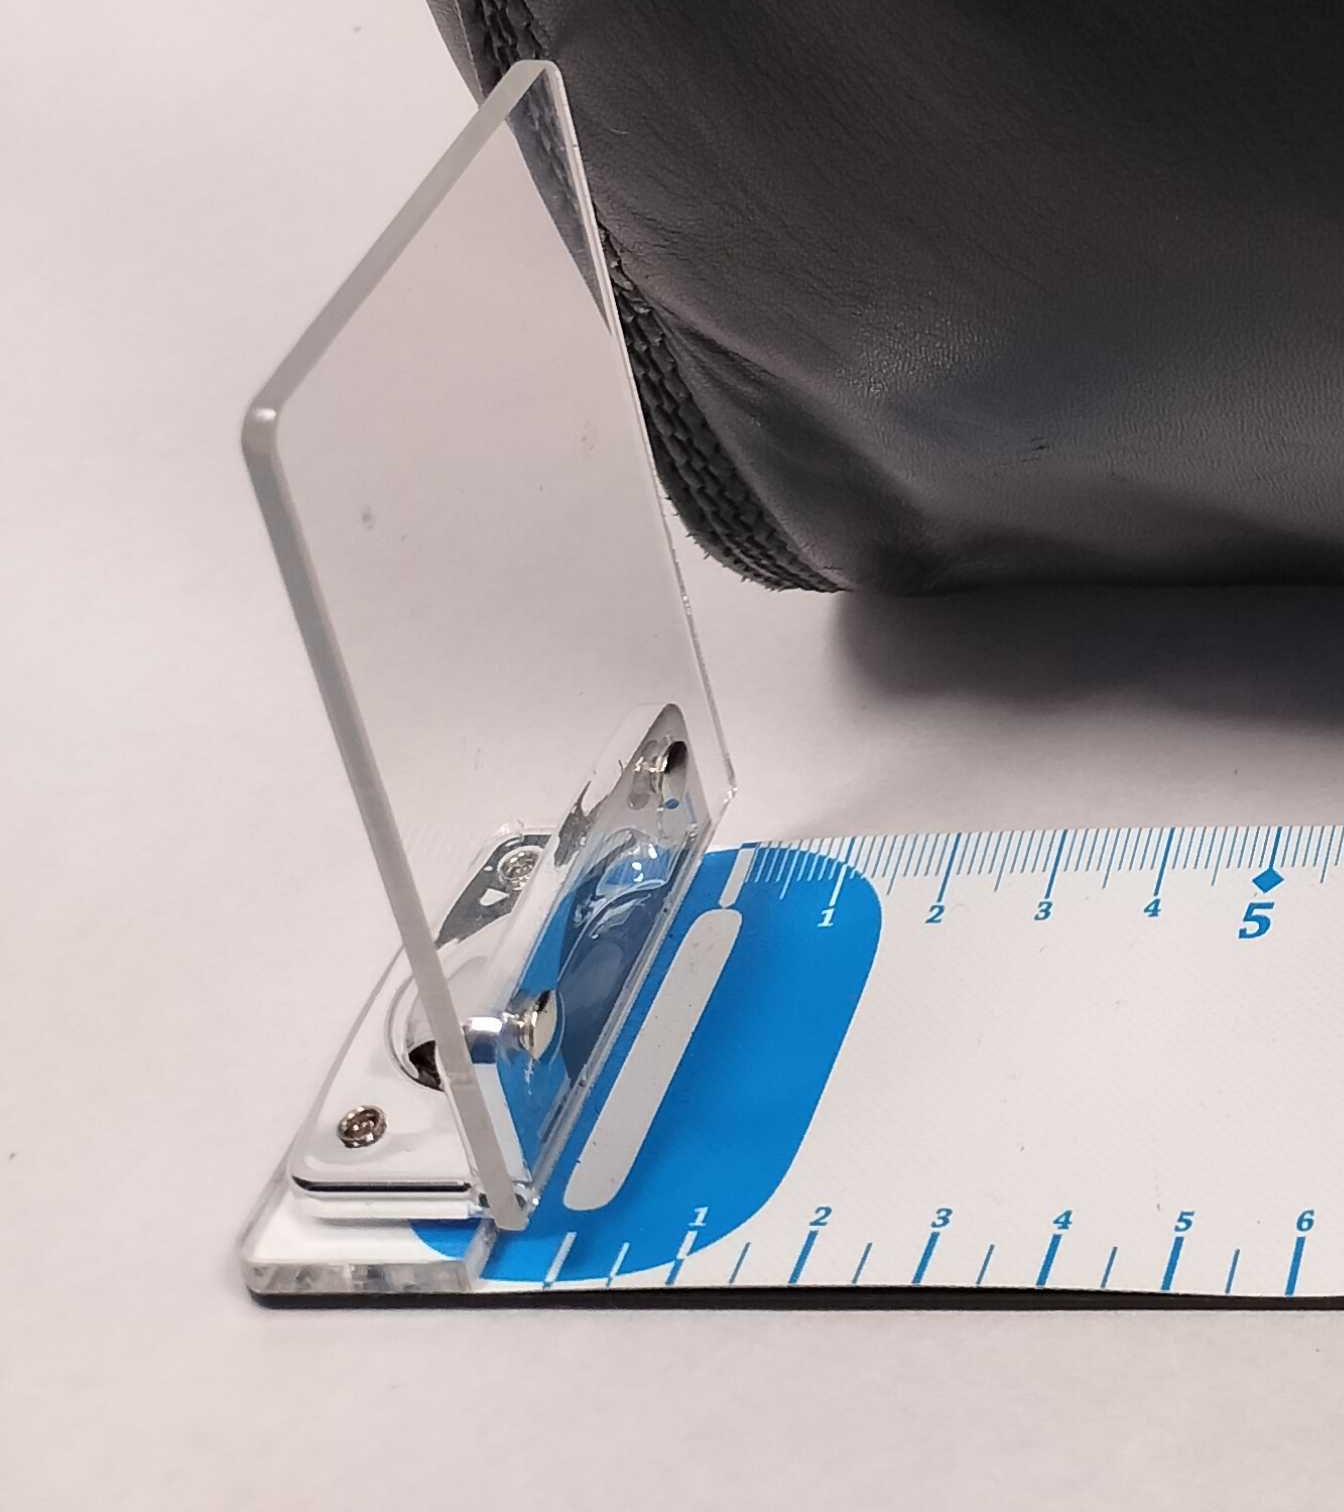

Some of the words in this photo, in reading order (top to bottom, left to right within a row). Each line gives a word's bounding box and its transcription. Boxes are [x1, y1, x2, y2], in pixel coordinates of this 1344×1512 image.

[818, 909, 835, 928] 1
[926, 906, 944, 924] 2
[1034, 902, 1052, 920] 3
[1143, 899, 1162, 918] 4
[1238, 902, 1274, 939] 5
[691, 1207, 709, 1226] 1
[810, 1207, 832, 1226] 2
[931, 1208, 952, 1227] 3
[1052, 1210, 1073, 1229] 4
[1174, 1210, 1194, 1231] 5
[1296, 1210, 1314, 1231] 6
